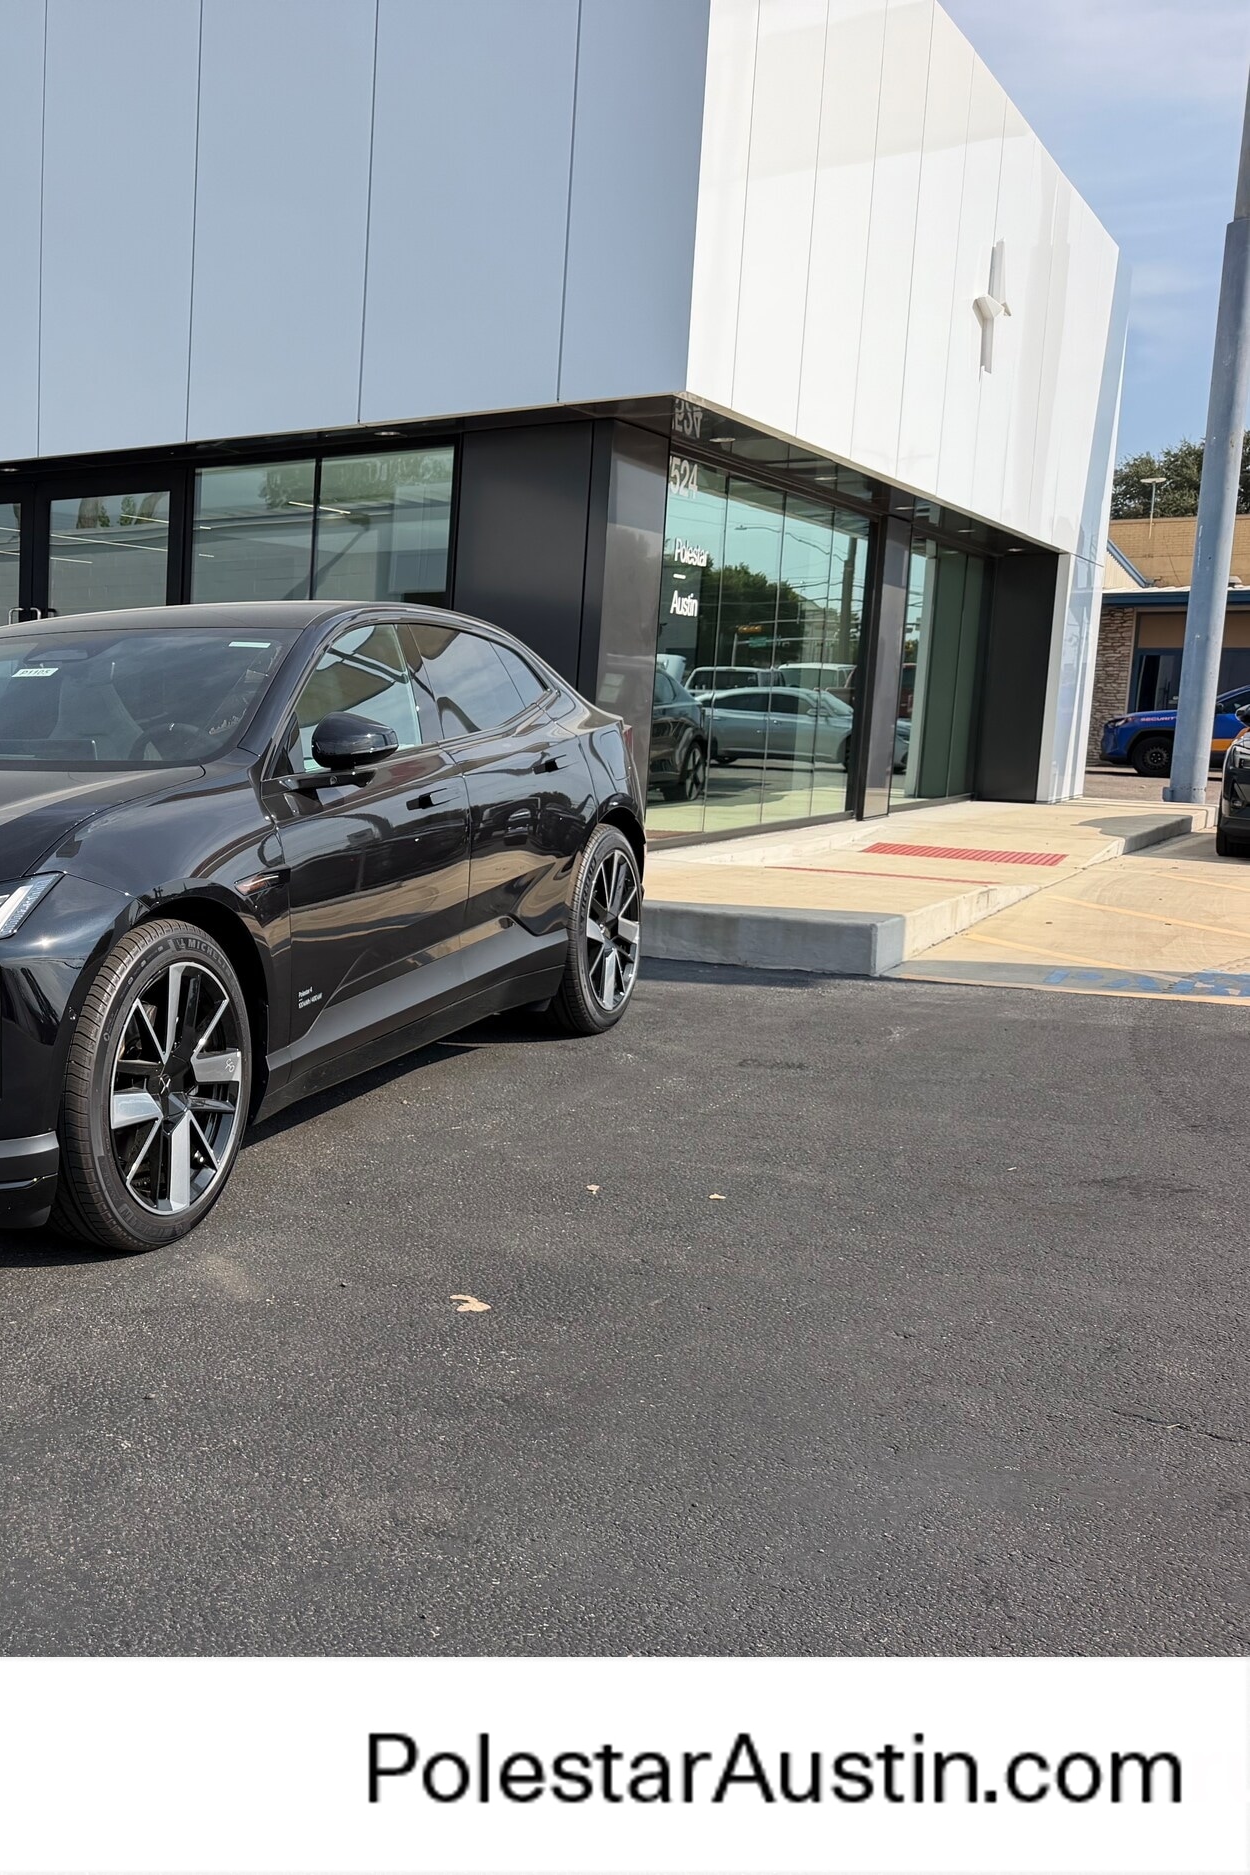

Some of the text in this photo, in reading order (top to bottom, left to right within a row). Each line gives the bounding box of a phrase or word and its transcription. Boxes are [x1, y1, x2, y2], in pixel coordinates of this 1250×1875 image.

[669, 456, 699, 499] 524
[674, 537, 710, 567] Polestar
[670, 590, 699, 617] Austin
